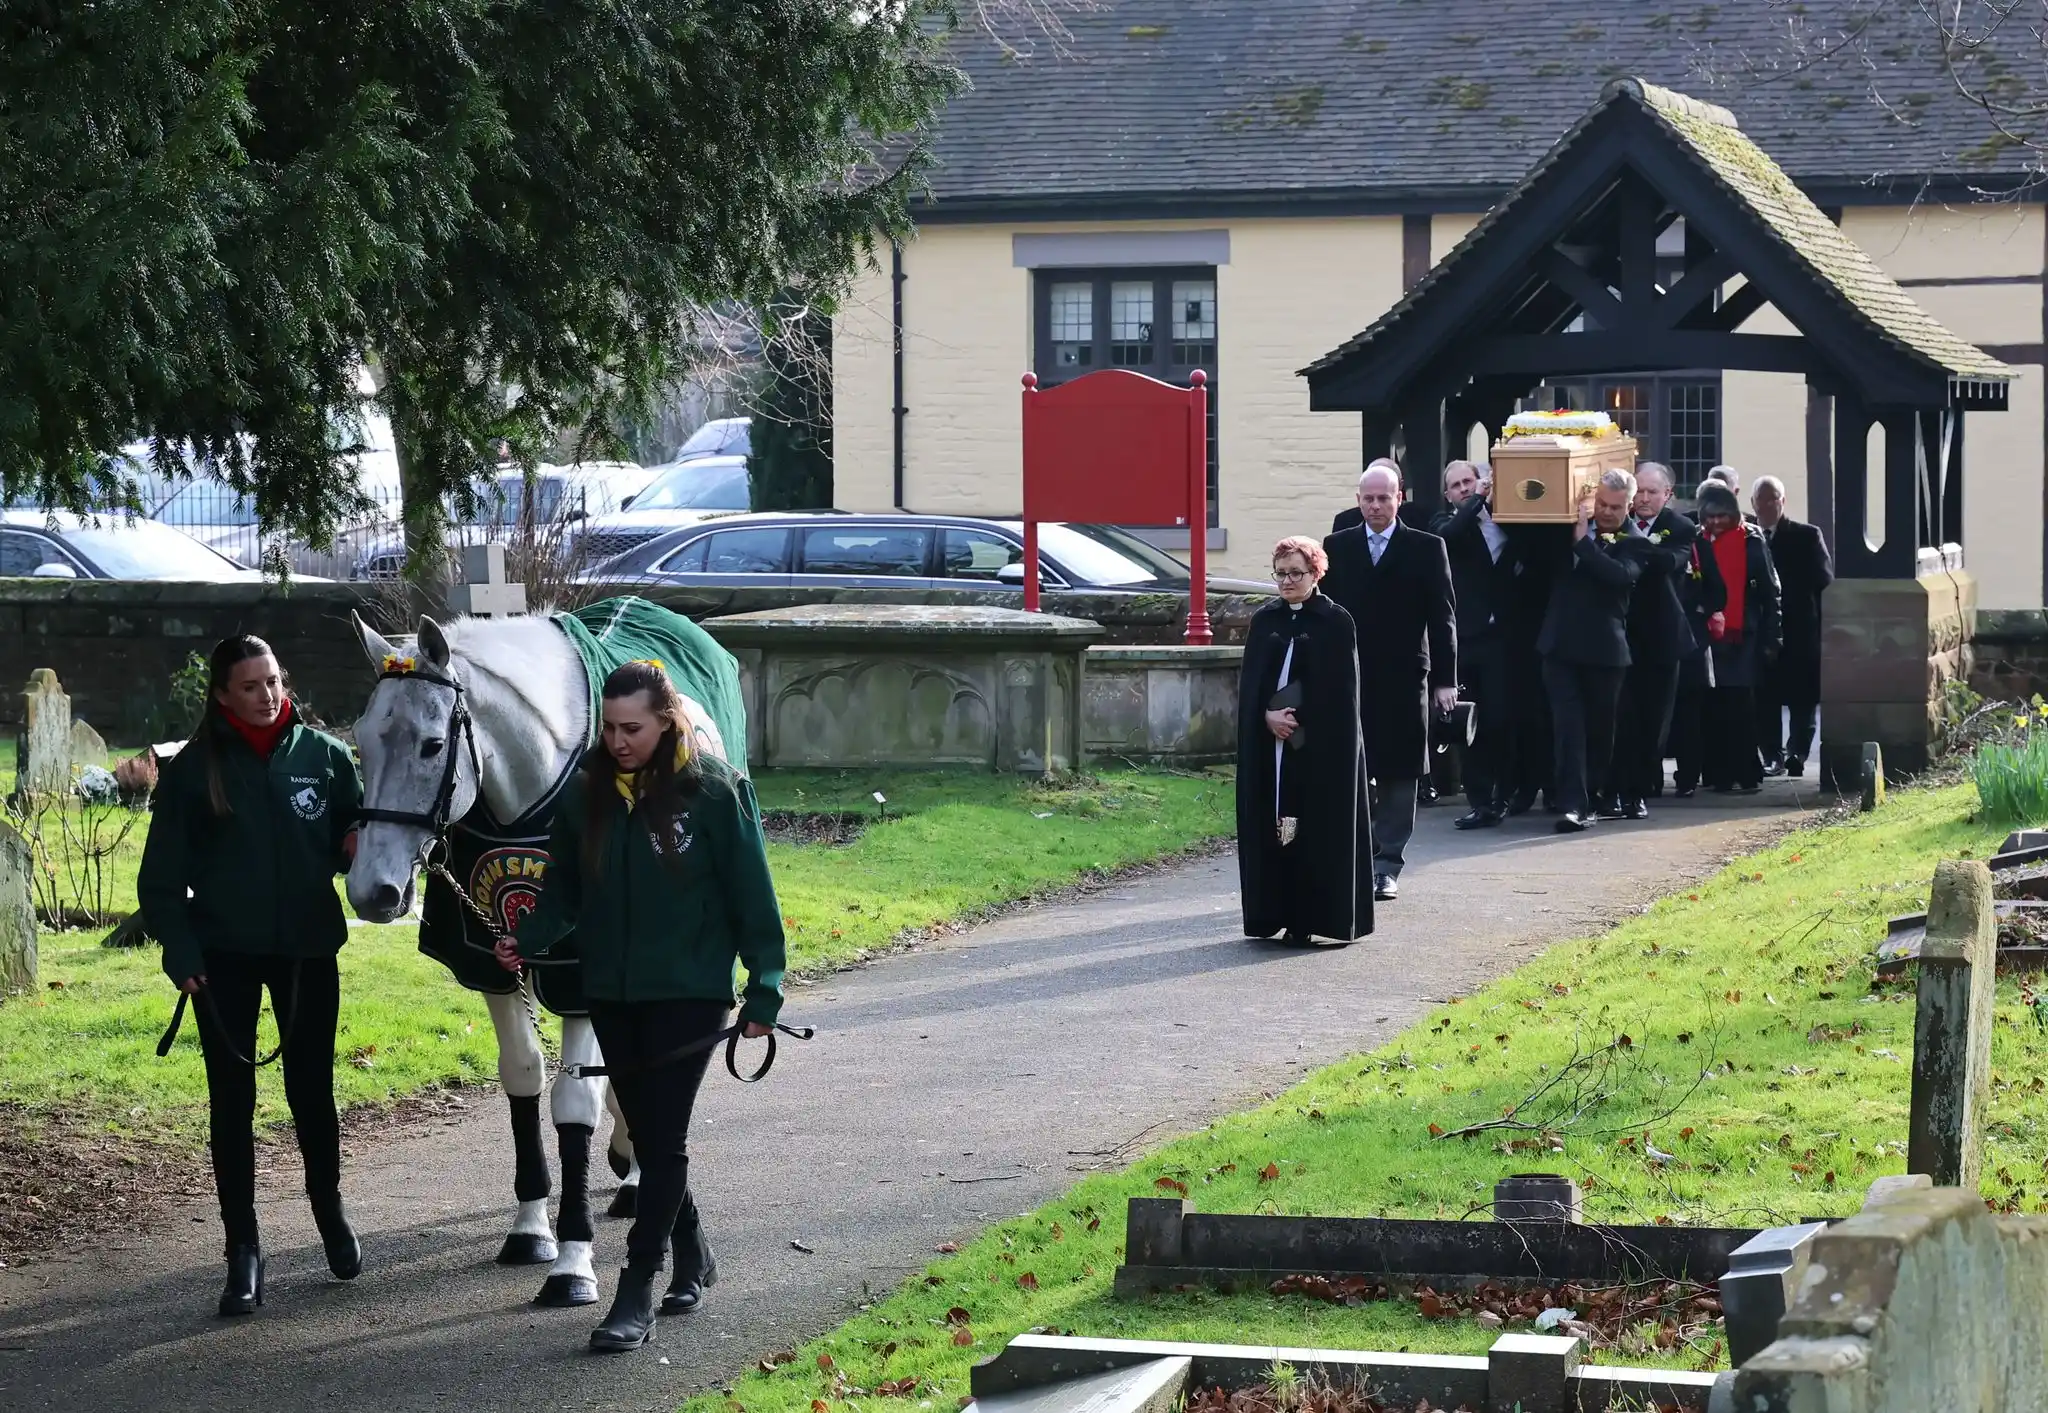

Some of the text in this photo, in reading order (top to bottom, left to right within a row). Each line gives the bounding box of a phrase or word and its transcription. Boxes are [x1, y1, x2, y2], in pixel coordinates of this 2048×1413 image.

[290, 776, 320, 784] RANDOX
[289, 795, 327, 820] GRAND NATIONAL
[674, 832, 694, 854] IONAL
[476, 856, 548, 918] JOHN SM
